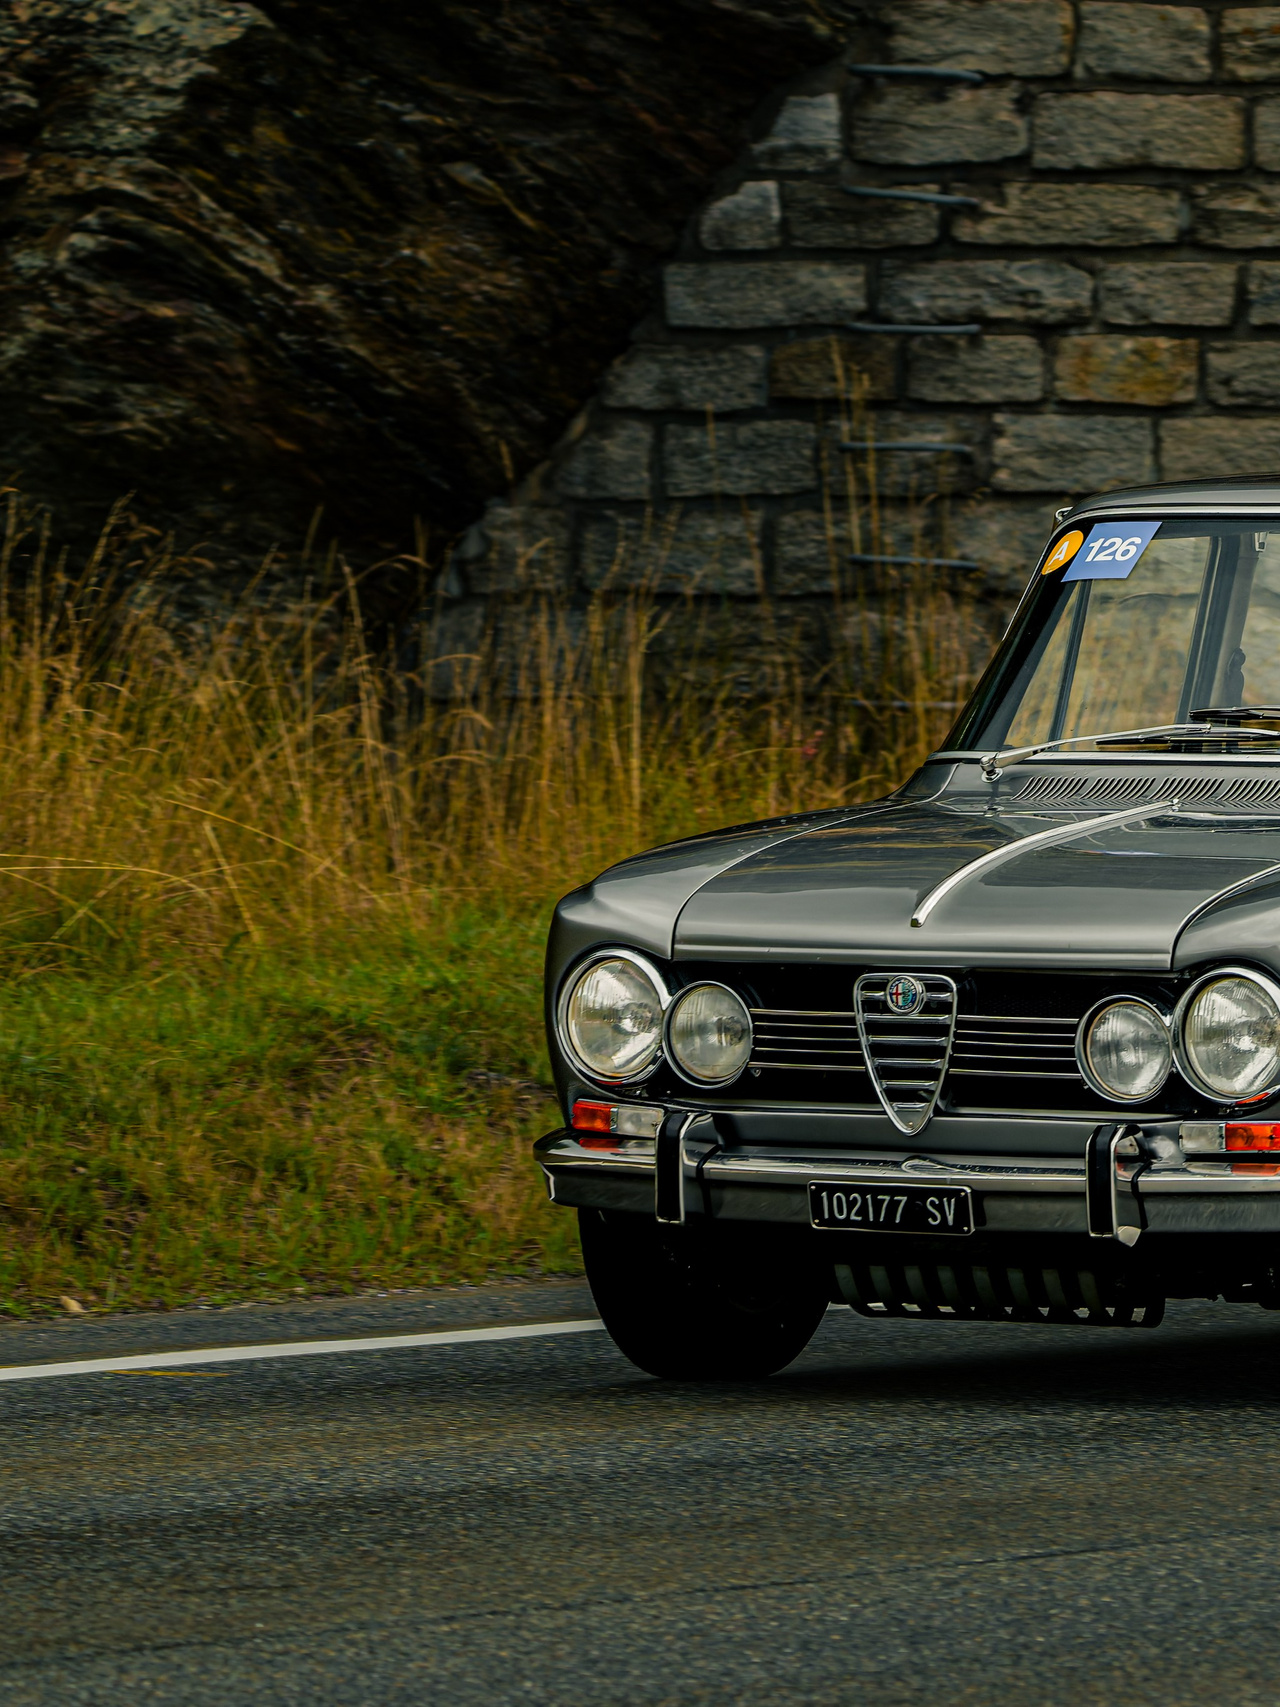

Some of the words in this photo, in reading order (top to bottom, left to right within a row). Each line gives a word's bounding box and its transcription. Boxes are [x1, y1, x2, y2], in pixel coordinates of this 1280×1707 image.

[1047, 541, 1070, 566] A
[1085, 536, 1142, 562] 126
[820, 1191, 908, 1223] 102177
[926, 1197, 956, 1226] SV
